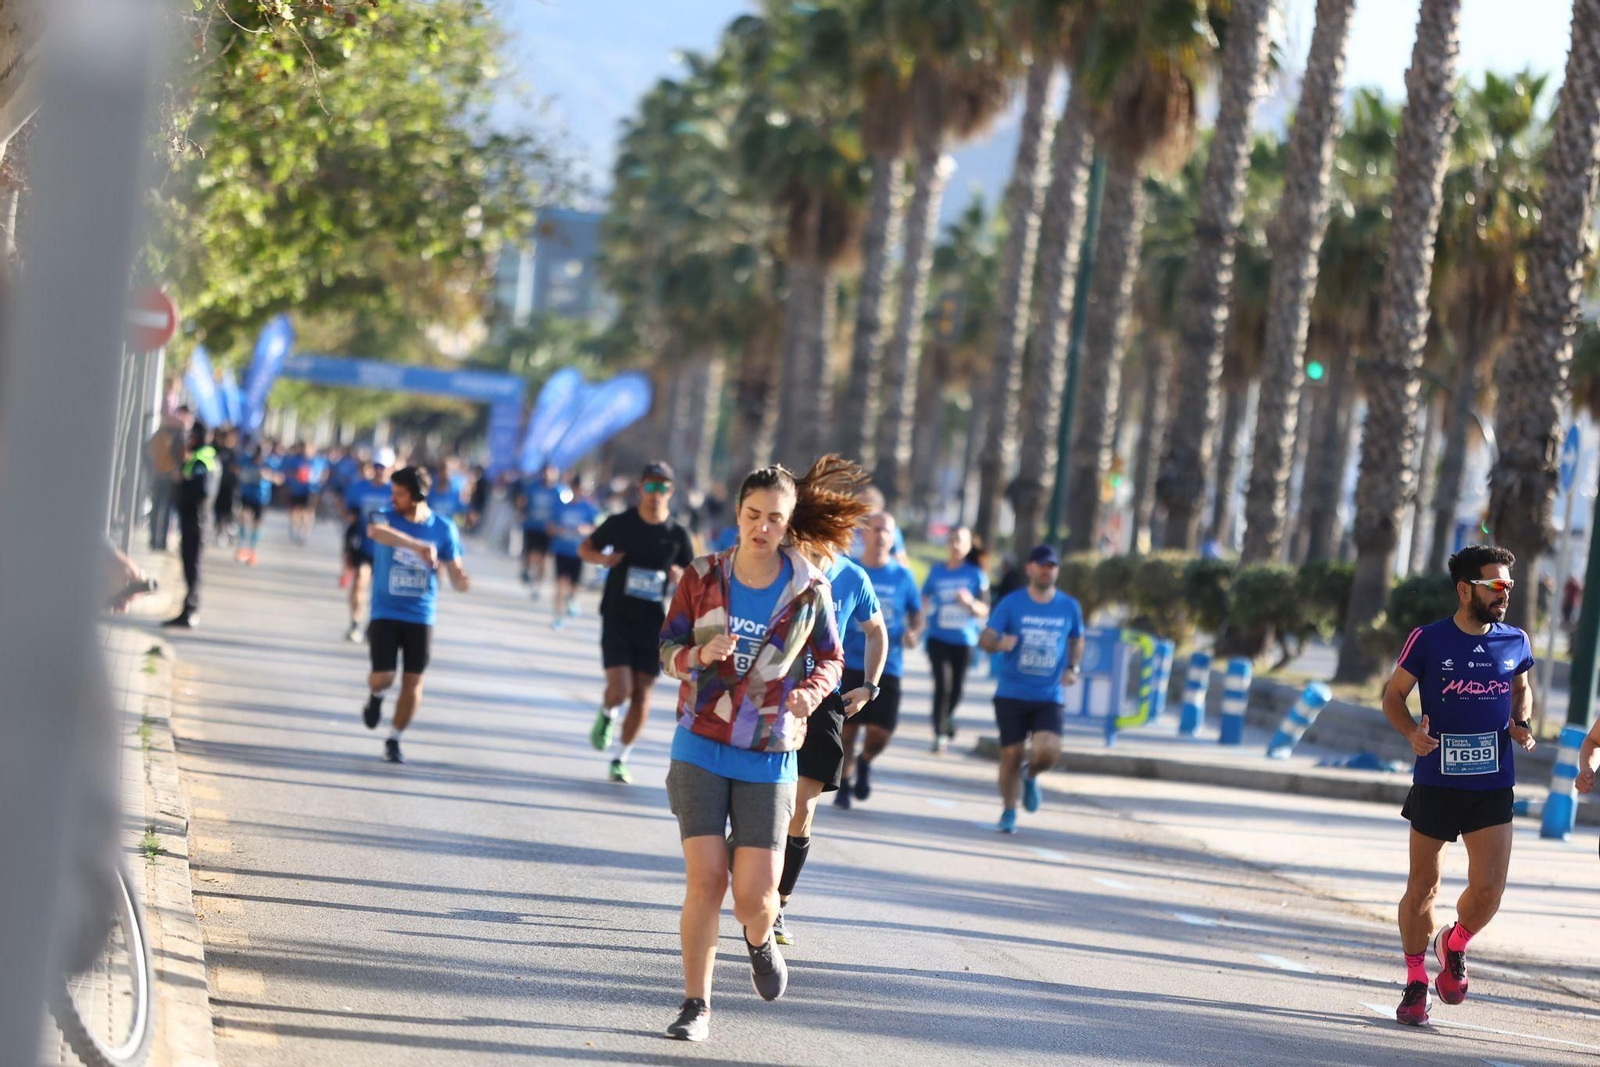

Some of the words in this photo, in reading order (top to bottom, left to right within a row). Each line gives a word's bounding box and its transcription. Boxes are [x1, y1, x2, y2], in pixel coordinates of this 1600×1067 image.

[1021, 615, 1065, 628] mayoral
[1442, 680, 1510, 695] MADRID
[1449, 748, 1491, 761] 1699
